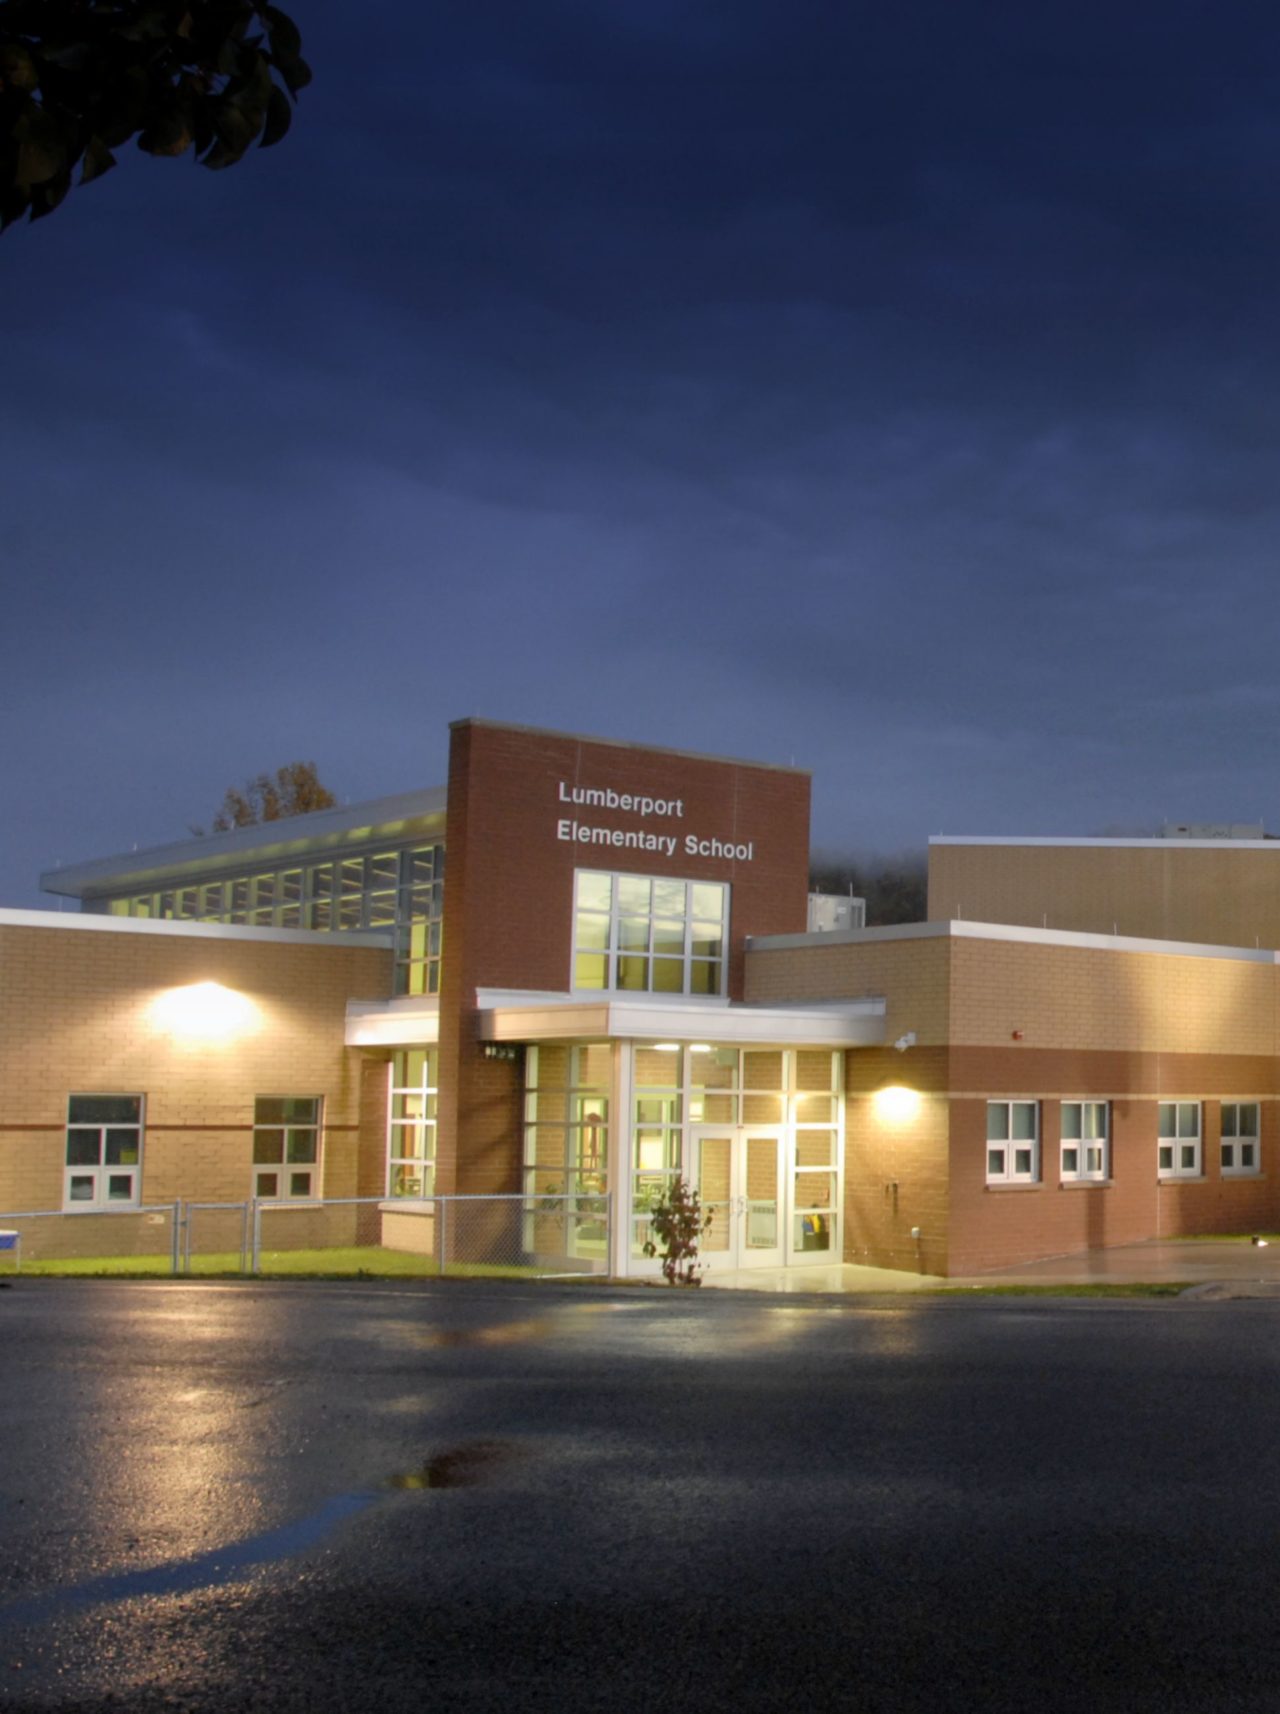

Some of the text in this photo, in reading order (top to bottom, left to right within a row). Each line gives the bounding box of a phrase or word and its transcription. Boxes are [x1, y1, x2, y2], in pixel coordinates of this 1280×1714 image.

[559, 782, 683, 816] Lumberport
[557, 820, 752, 860] Elementary School
